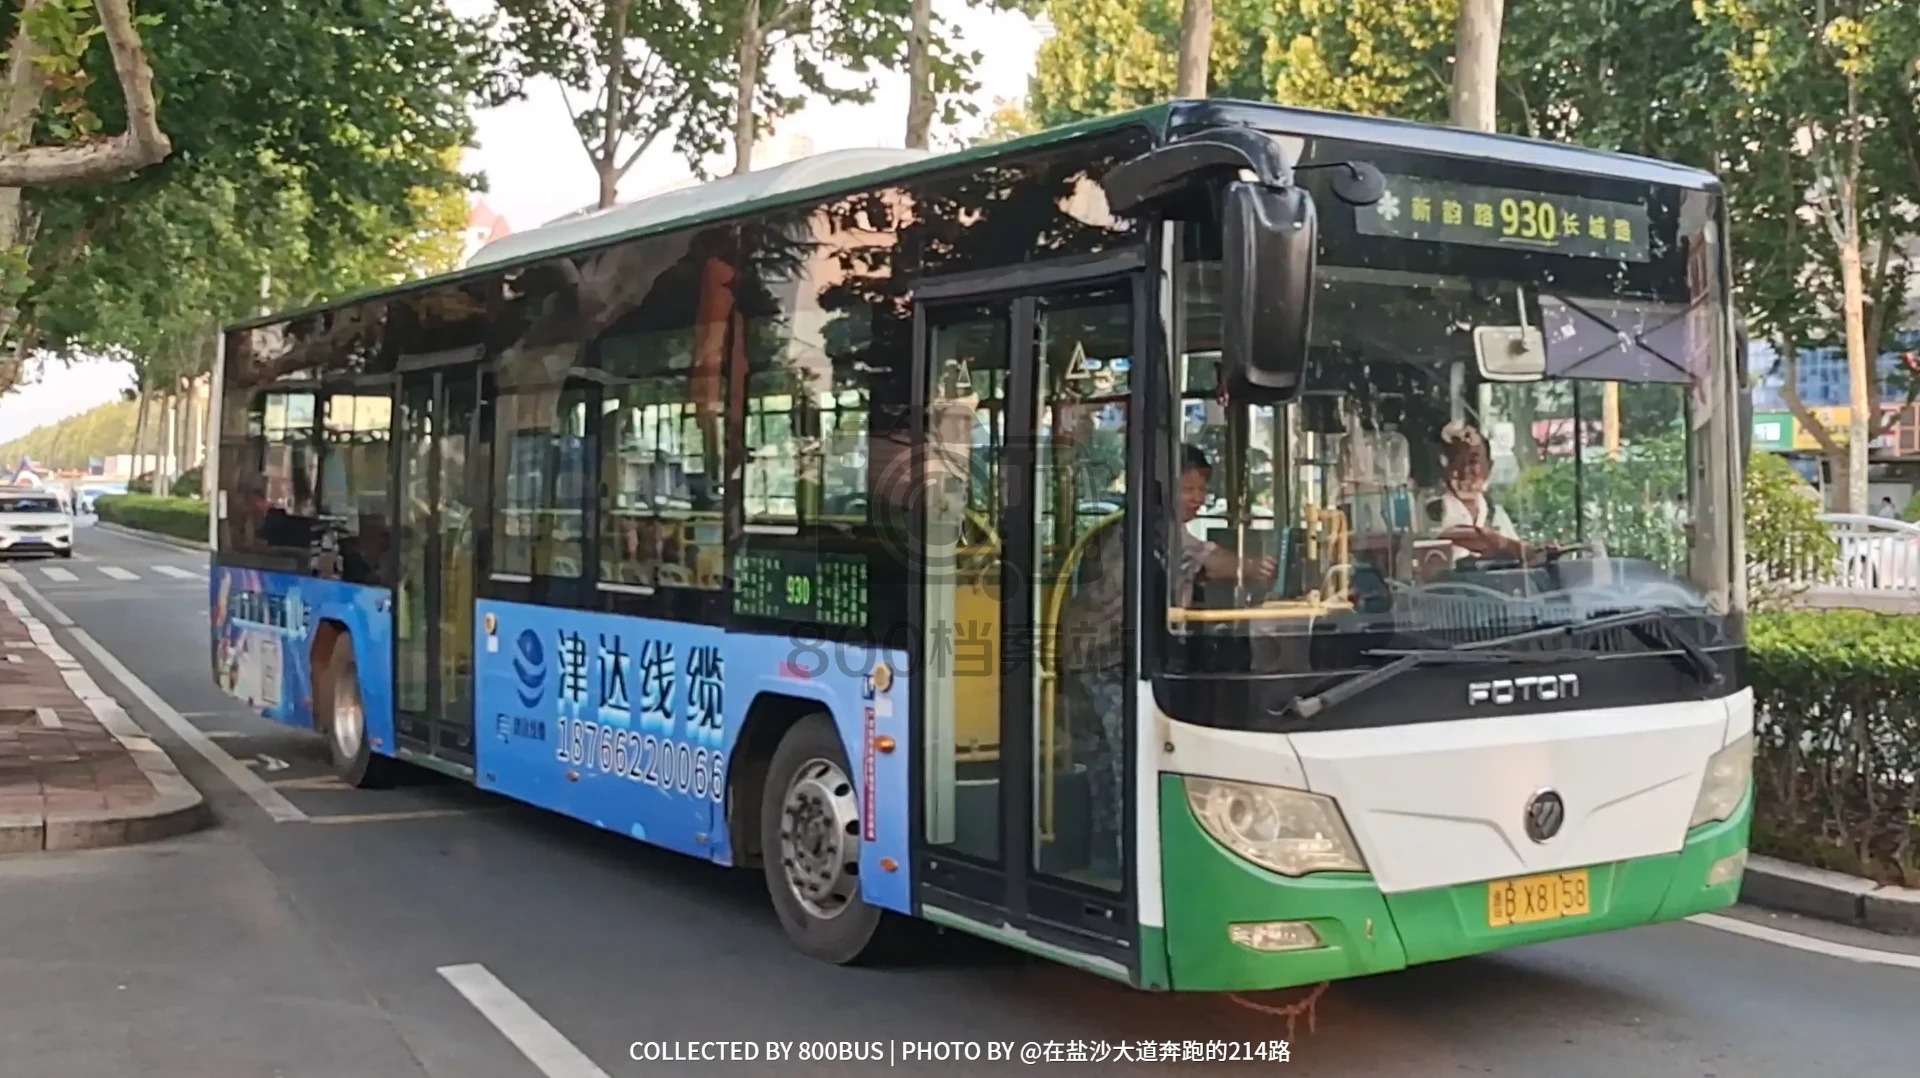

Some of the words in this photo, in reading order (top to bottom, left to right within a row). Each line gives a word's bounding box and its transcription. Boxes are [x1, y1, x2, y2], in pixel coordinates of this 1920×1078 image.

[1500, 197, 1556, 240] 930
[1562, 211, 1632, 243] 长城路
[786, 574, 811, 605] 930
[557, 628, 725, 730] 津达线缆
[1468, 673, 1579, 706] FOTON
[556, 716, 725, 803] 18766220066
